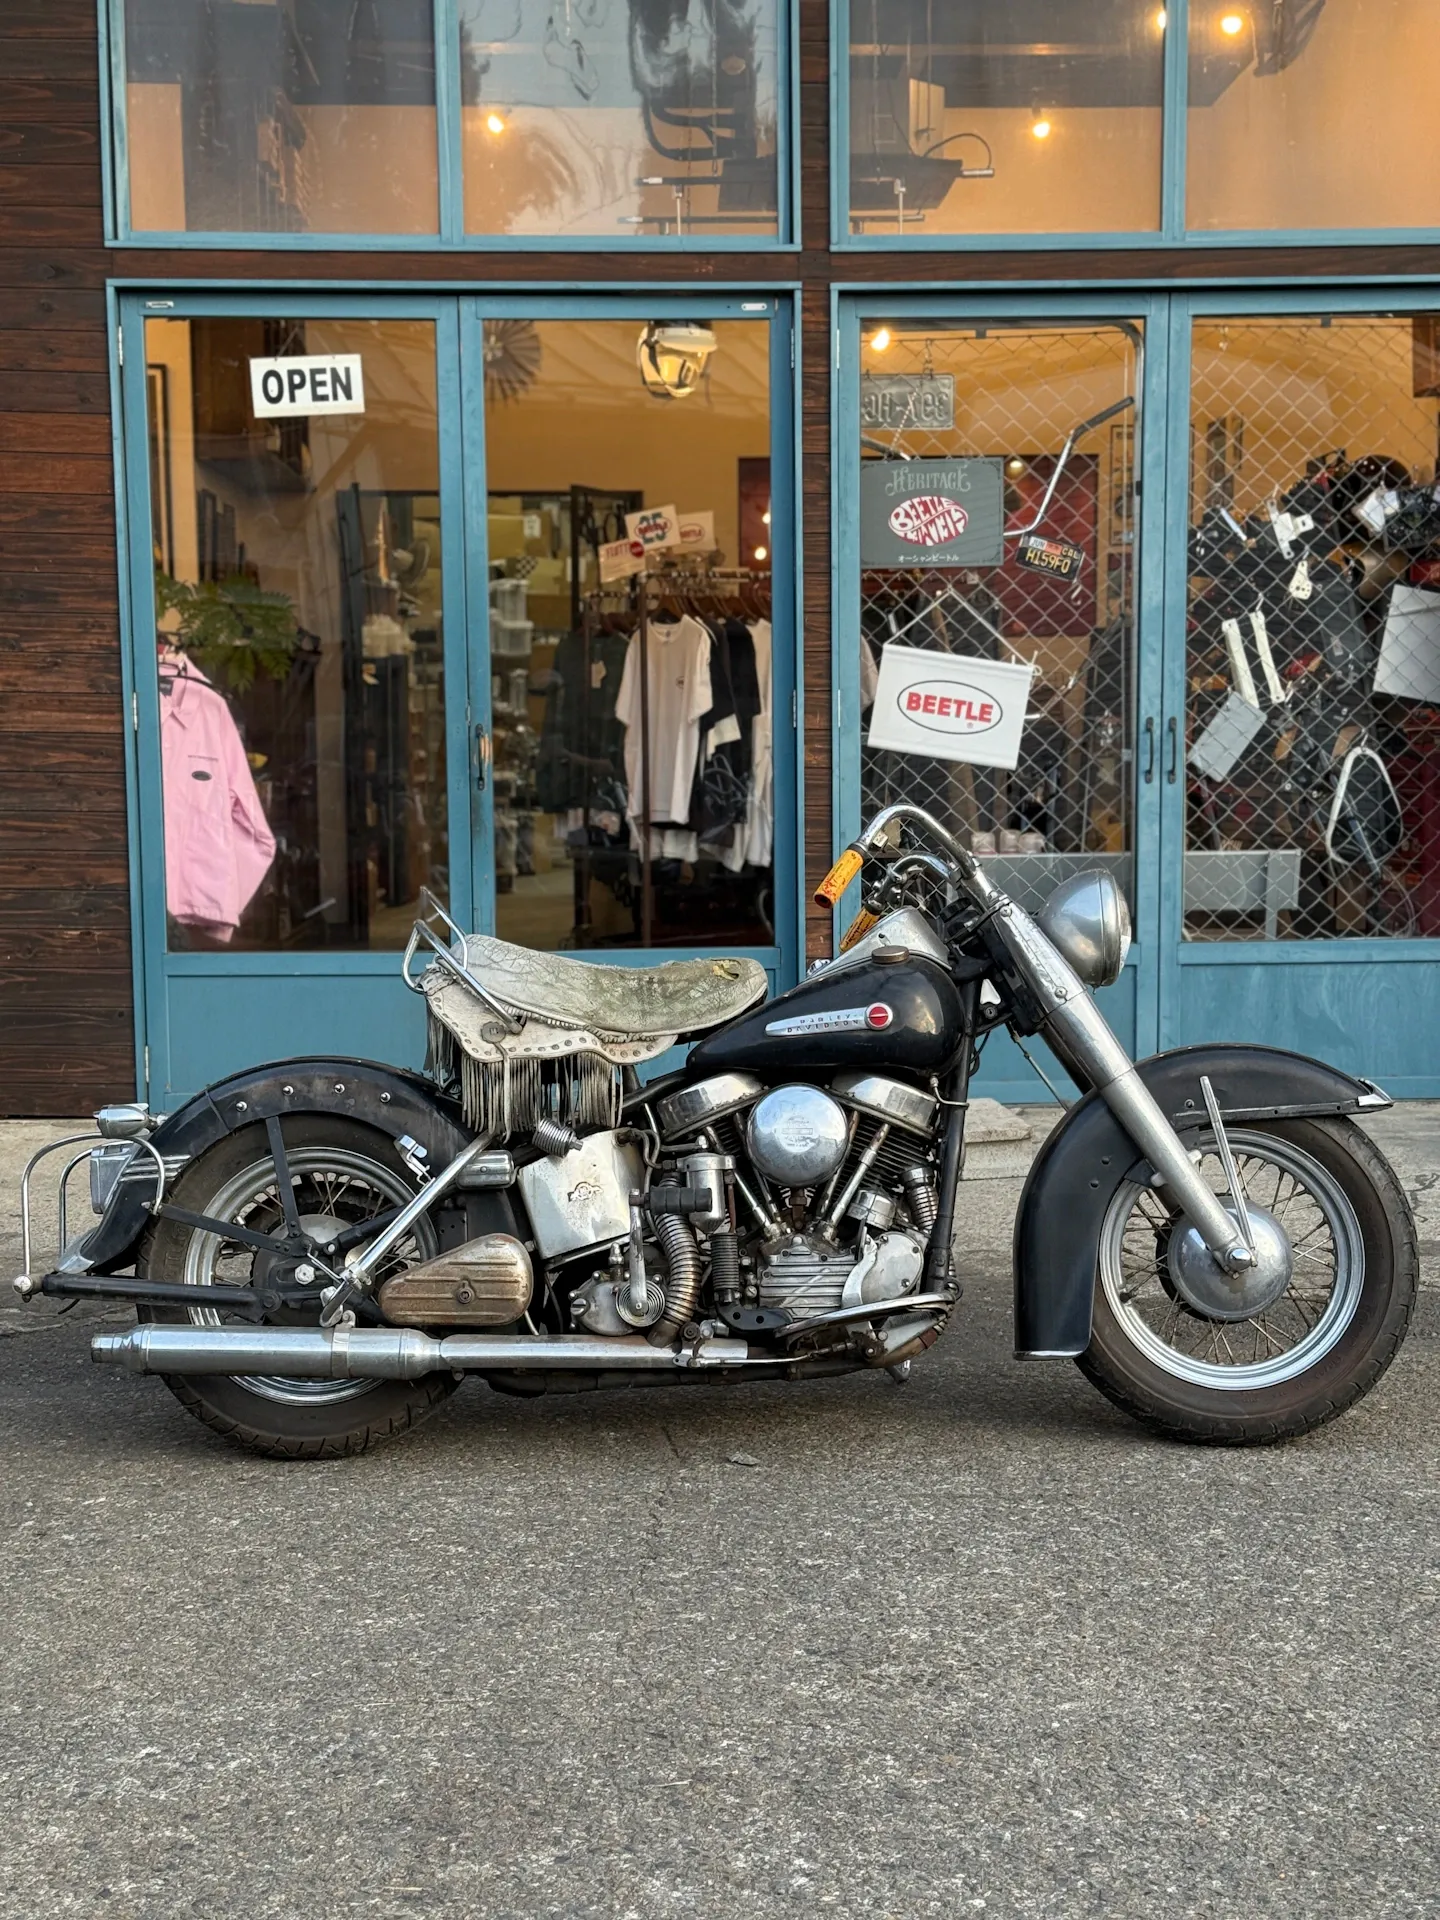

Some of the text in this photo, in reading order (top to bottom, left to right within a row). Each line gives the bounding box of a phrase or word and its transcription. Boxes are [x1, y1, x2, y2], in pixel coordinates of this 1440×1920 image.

[262, 366, 353, 404] OPEN
[885, 461, 971, 496] HERITAGE
[890, 496, 957, 532] BEETLE
[898, 553, 960, 563] オーシャンビートル
[906, 692, 994, 723] BEETLE
[787, 1020, 859, 1033] DAVIDSON
